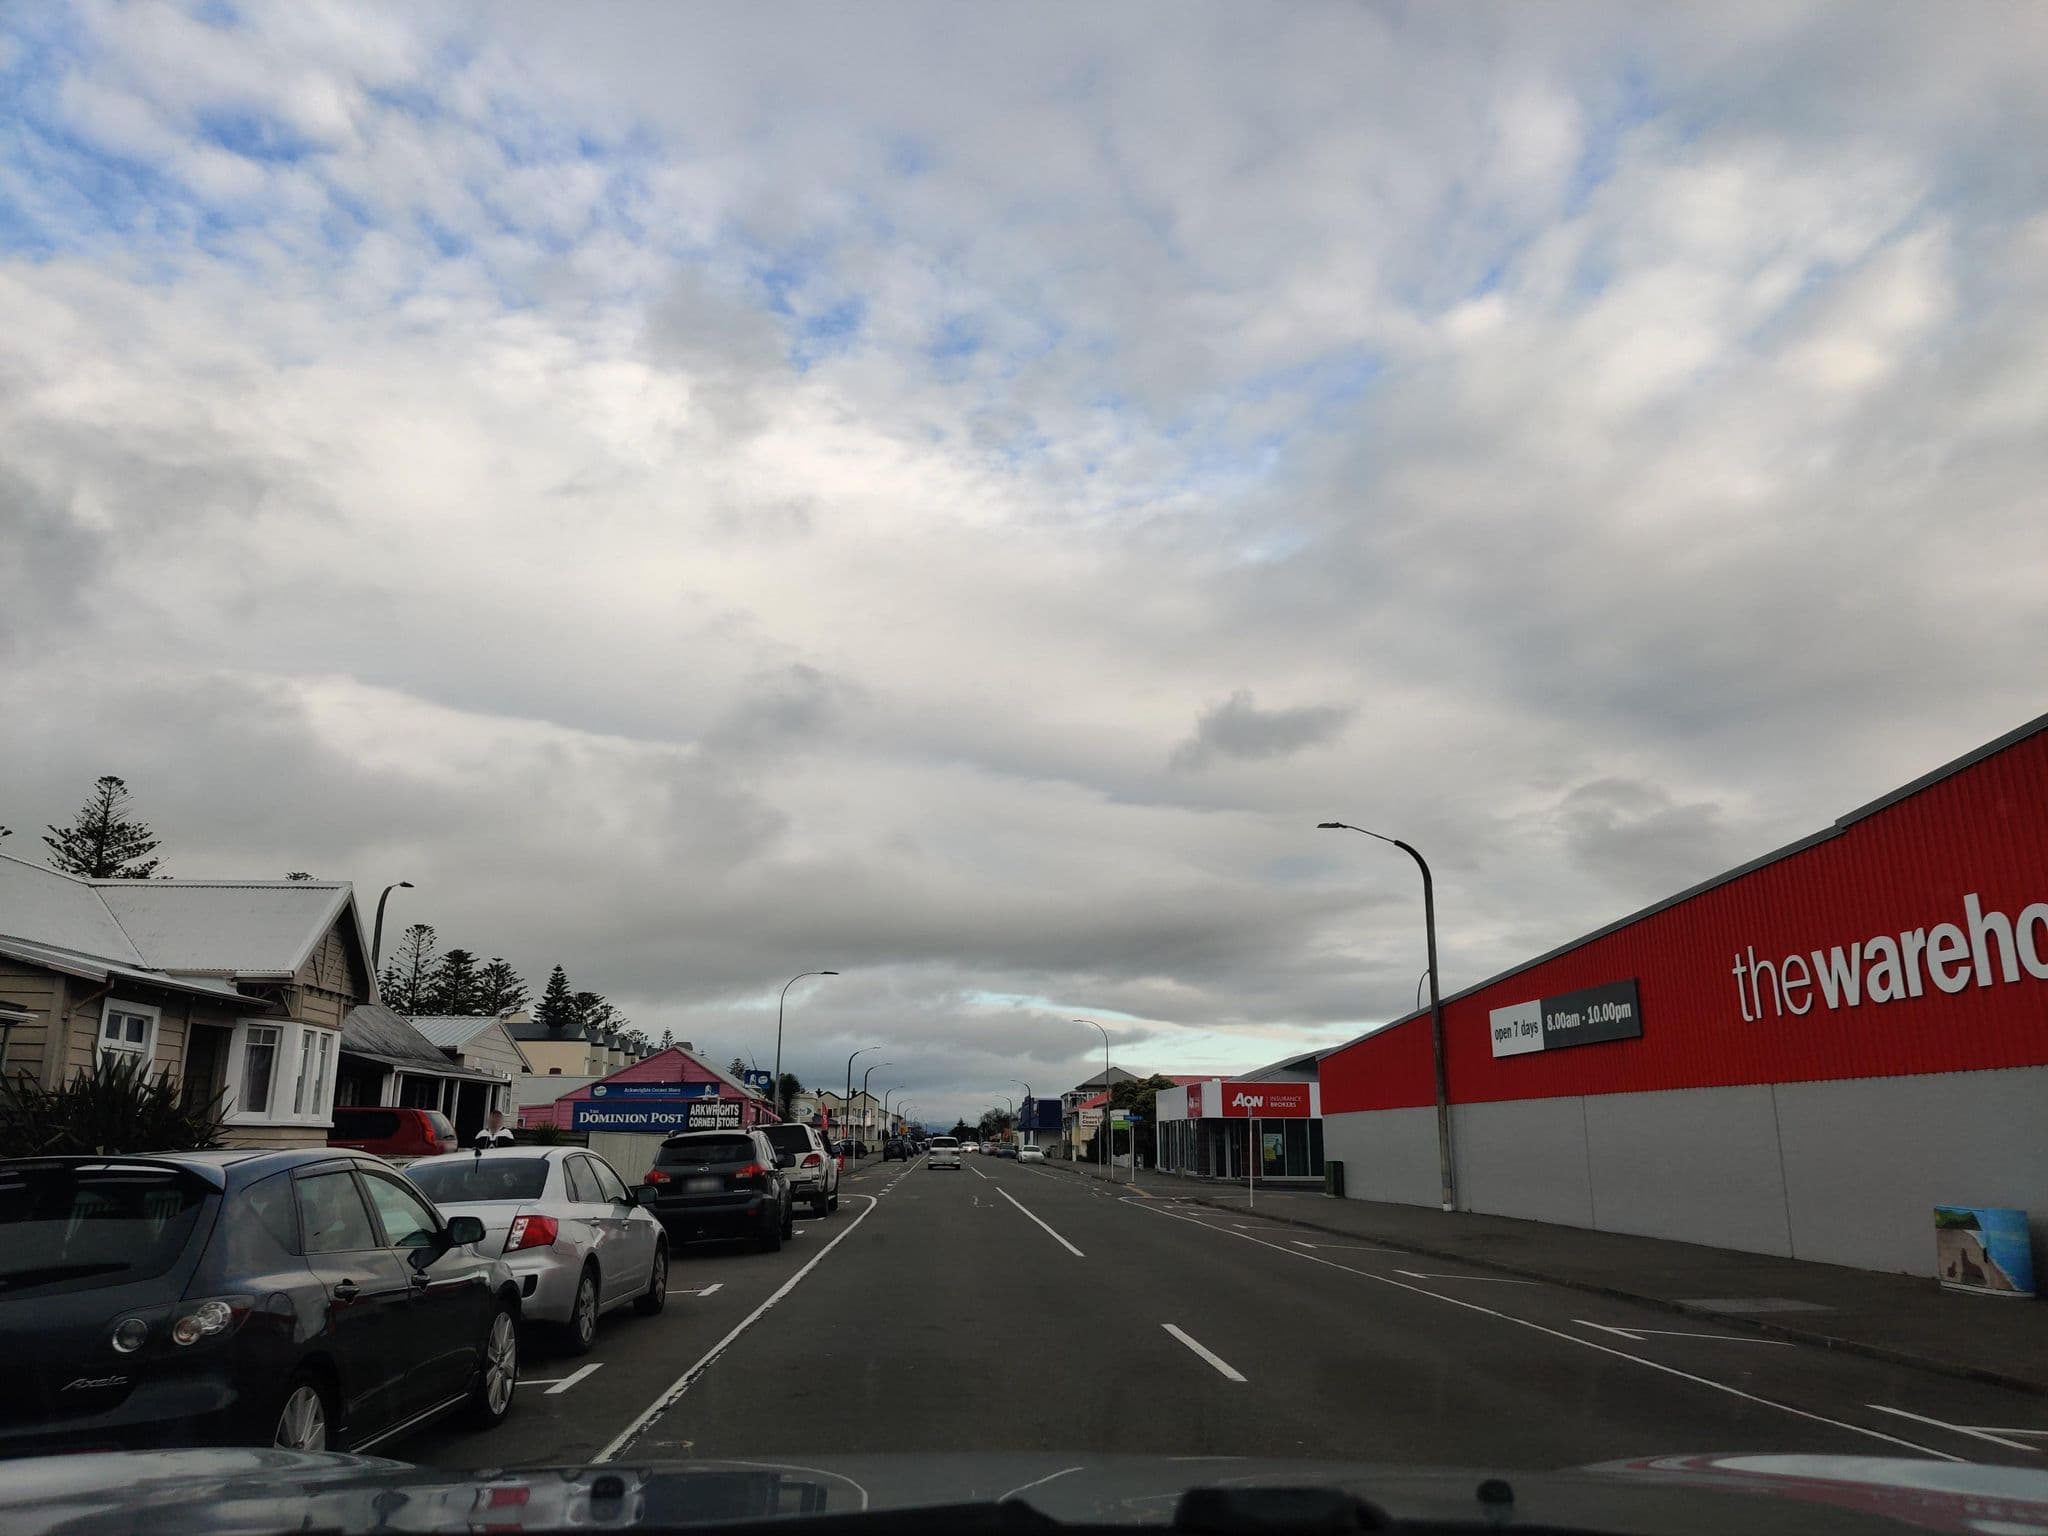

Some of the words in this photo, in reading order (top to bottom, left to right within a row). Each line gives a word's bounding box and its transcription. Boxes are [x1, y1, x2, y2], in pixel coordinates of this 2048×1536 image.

[1546, 1012, 1580, 1031] 8.00am
[1587, 1002, 1632, 1023] 10.00pm
[1494, 1026, 1512, 1043] open
[1513, 1021, 1519, 1037] 7
[1520, 1019, 1539, 1038] days
[1232, 1092, 1264, 1107] AON
[690, 1104, 739, 1115] ARKWRGHTS
[579, 1111, 648, 1123] DOMINION
[650, 1112, 684, 1123] POST
[688, 1117, 716, 1127] CORNER
[717, 1117, 739, 1127] STORE
